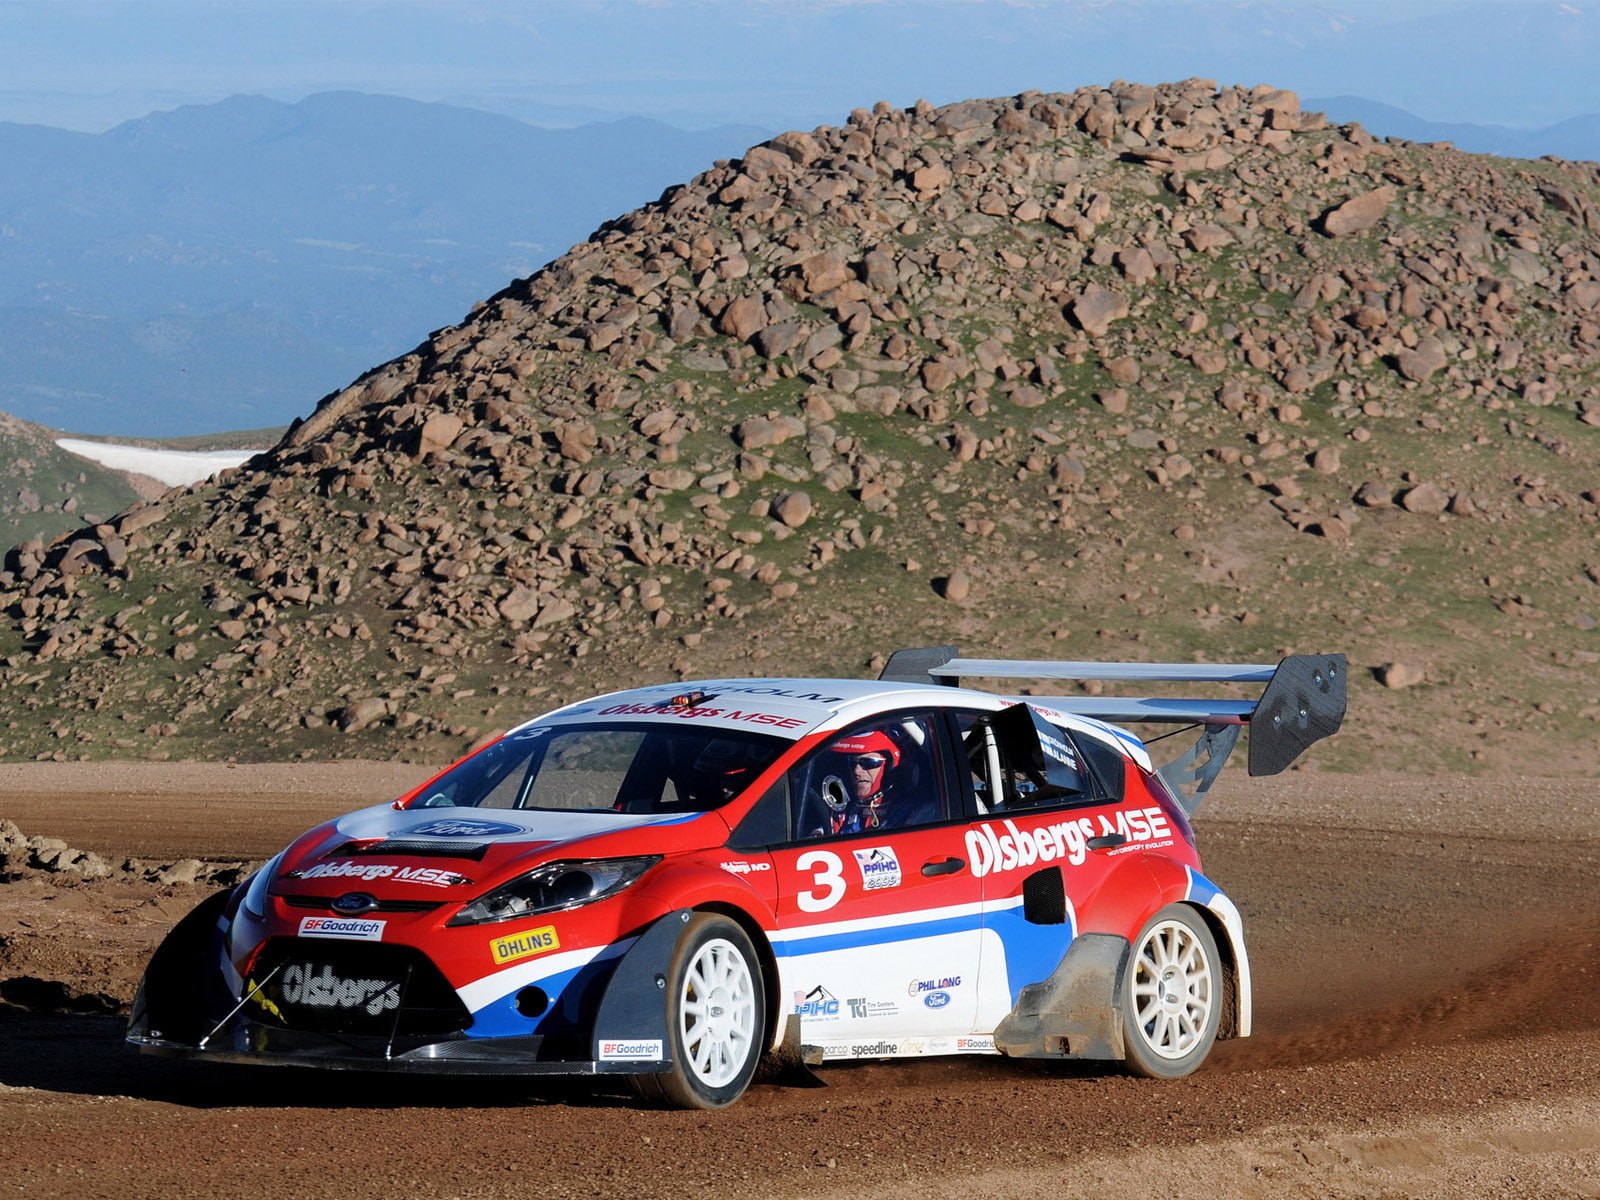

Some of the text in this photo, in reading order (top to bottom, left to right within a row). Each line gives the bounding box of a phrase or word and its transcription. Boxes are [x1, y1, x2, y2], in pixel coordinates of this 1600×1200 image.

[598, 702, 808, 729] Olsbergs MSE
[514, 727, 552, 740] 3
[414, 820, 500, 835] Ford
[964, 807, 1172, 878] Olsbergs MSE
[1106, 840, 1174, 856] MOTORSPORT EVOLUTION
[301, 861, 398, 880] Olsbergs
[395, 866, 462, 885] MSE
[796, 850, 847, 913] 3
[304, 920, 380, 932] BFGoodrich
[497, 933, 553, 958] ÖHLINS
[283, 963, 401, 1016] Olsbergs
[918, 976, 961, 992] PHIL LONG
[928, 992, 946, 1006] Ford
[603, 1043, 659, 1054] BFGoodrich
[824, 1045, 848, 1056] parco
[851, 1041, 897, 1059] speedline
[957, 1039, 996, 1048] BFGoodric
